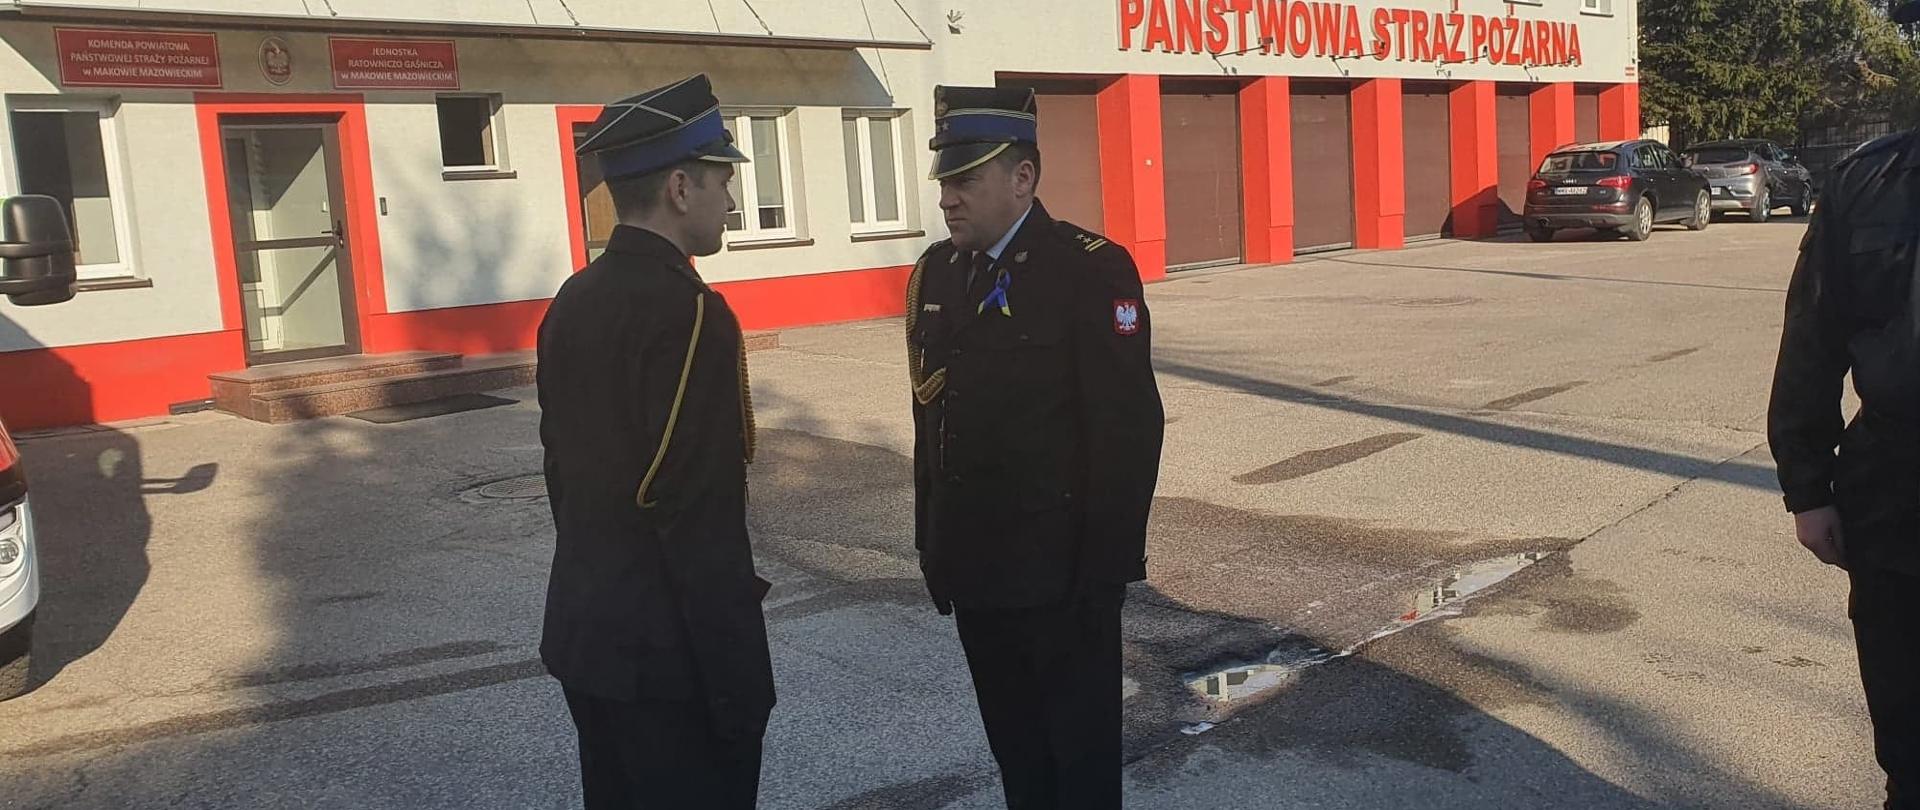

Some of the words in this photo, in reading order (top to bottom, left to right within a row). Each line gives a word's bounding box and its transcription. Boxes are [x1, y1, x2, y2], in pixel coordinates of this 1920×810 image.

[1372, 0, 1466, 64] STRAŻ
[1471, 2, 1582, 66] POŻARNA
[87, 39, 134, 50] KOMENDA
[135, 40, 190, 51] POWIATOWA
[70, 50, 133, 63] PAŃSTWOWEJ
[134, 53, 166, 64] STRAŻY
[167, 54, 210, 65] POŻARNEJ
[372, 47, 418, 56] JEDNOSTKA
[348, 58, 403, 68] RATOWNICZO
[404, 58, 444, 69] GAŚNICZA
[93, 66, 138, 77] MAKOWIE
[139, 68, 203, 78] MAZOWIECKIM
[350, 71, 393, 81] MAKOWIE
[394, 72, 453, 81] MAZOWIECKIM
